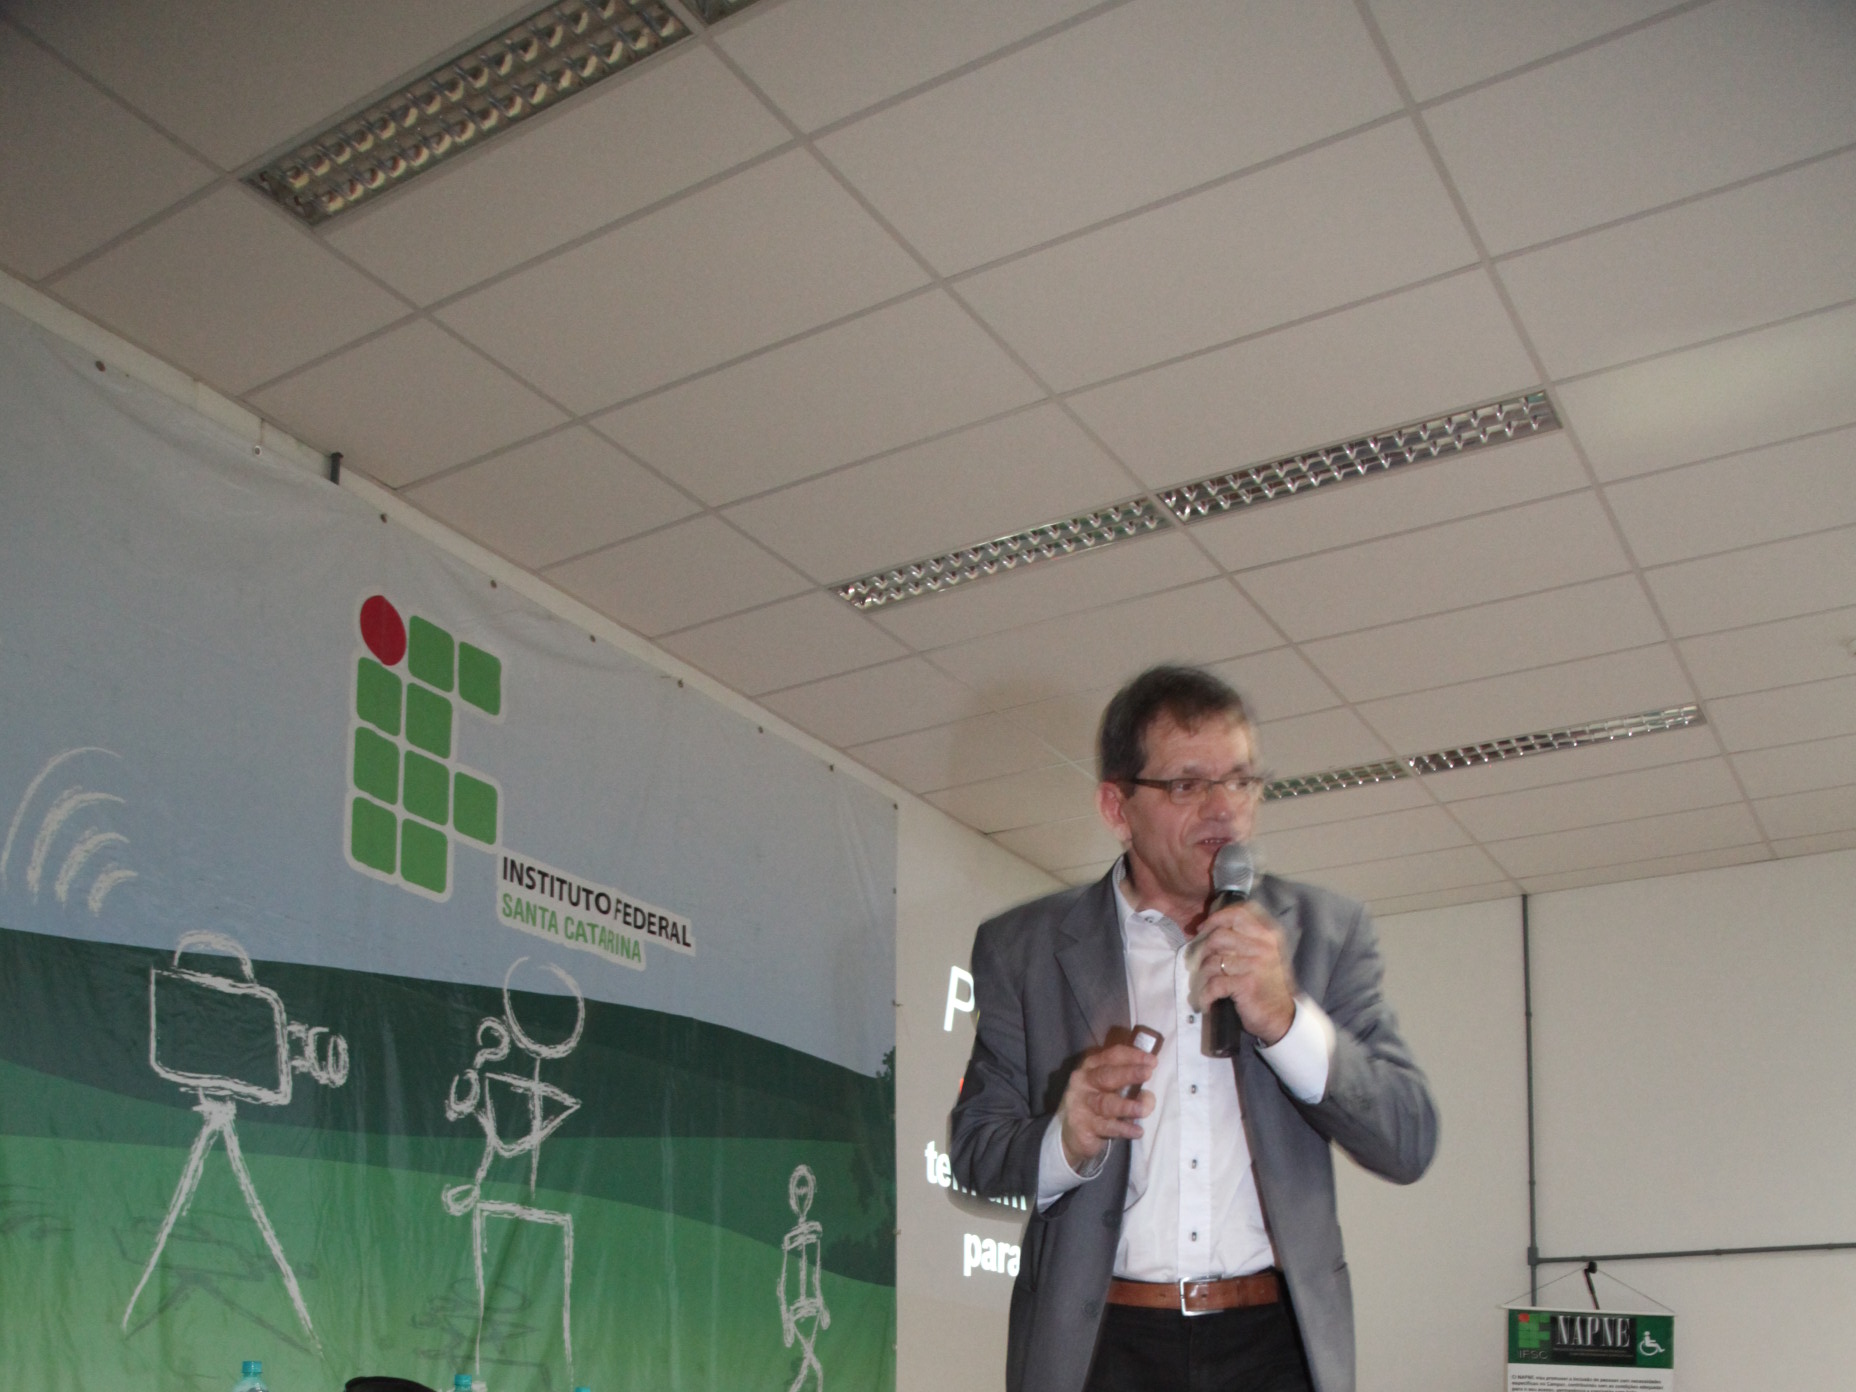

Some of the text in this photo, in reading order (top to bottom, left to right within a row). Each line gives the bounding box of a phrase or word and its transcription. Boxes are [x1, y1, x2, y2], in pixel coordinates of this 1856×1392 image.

[502, 856, 692, 948] INSTITUTO FEDERAL
[502, 892, 642, 963] SANTA CATARINA
[1518, 1350, 1549, 1360] IFSC
[1556, 1315, 1631, 1348] NAPNE
